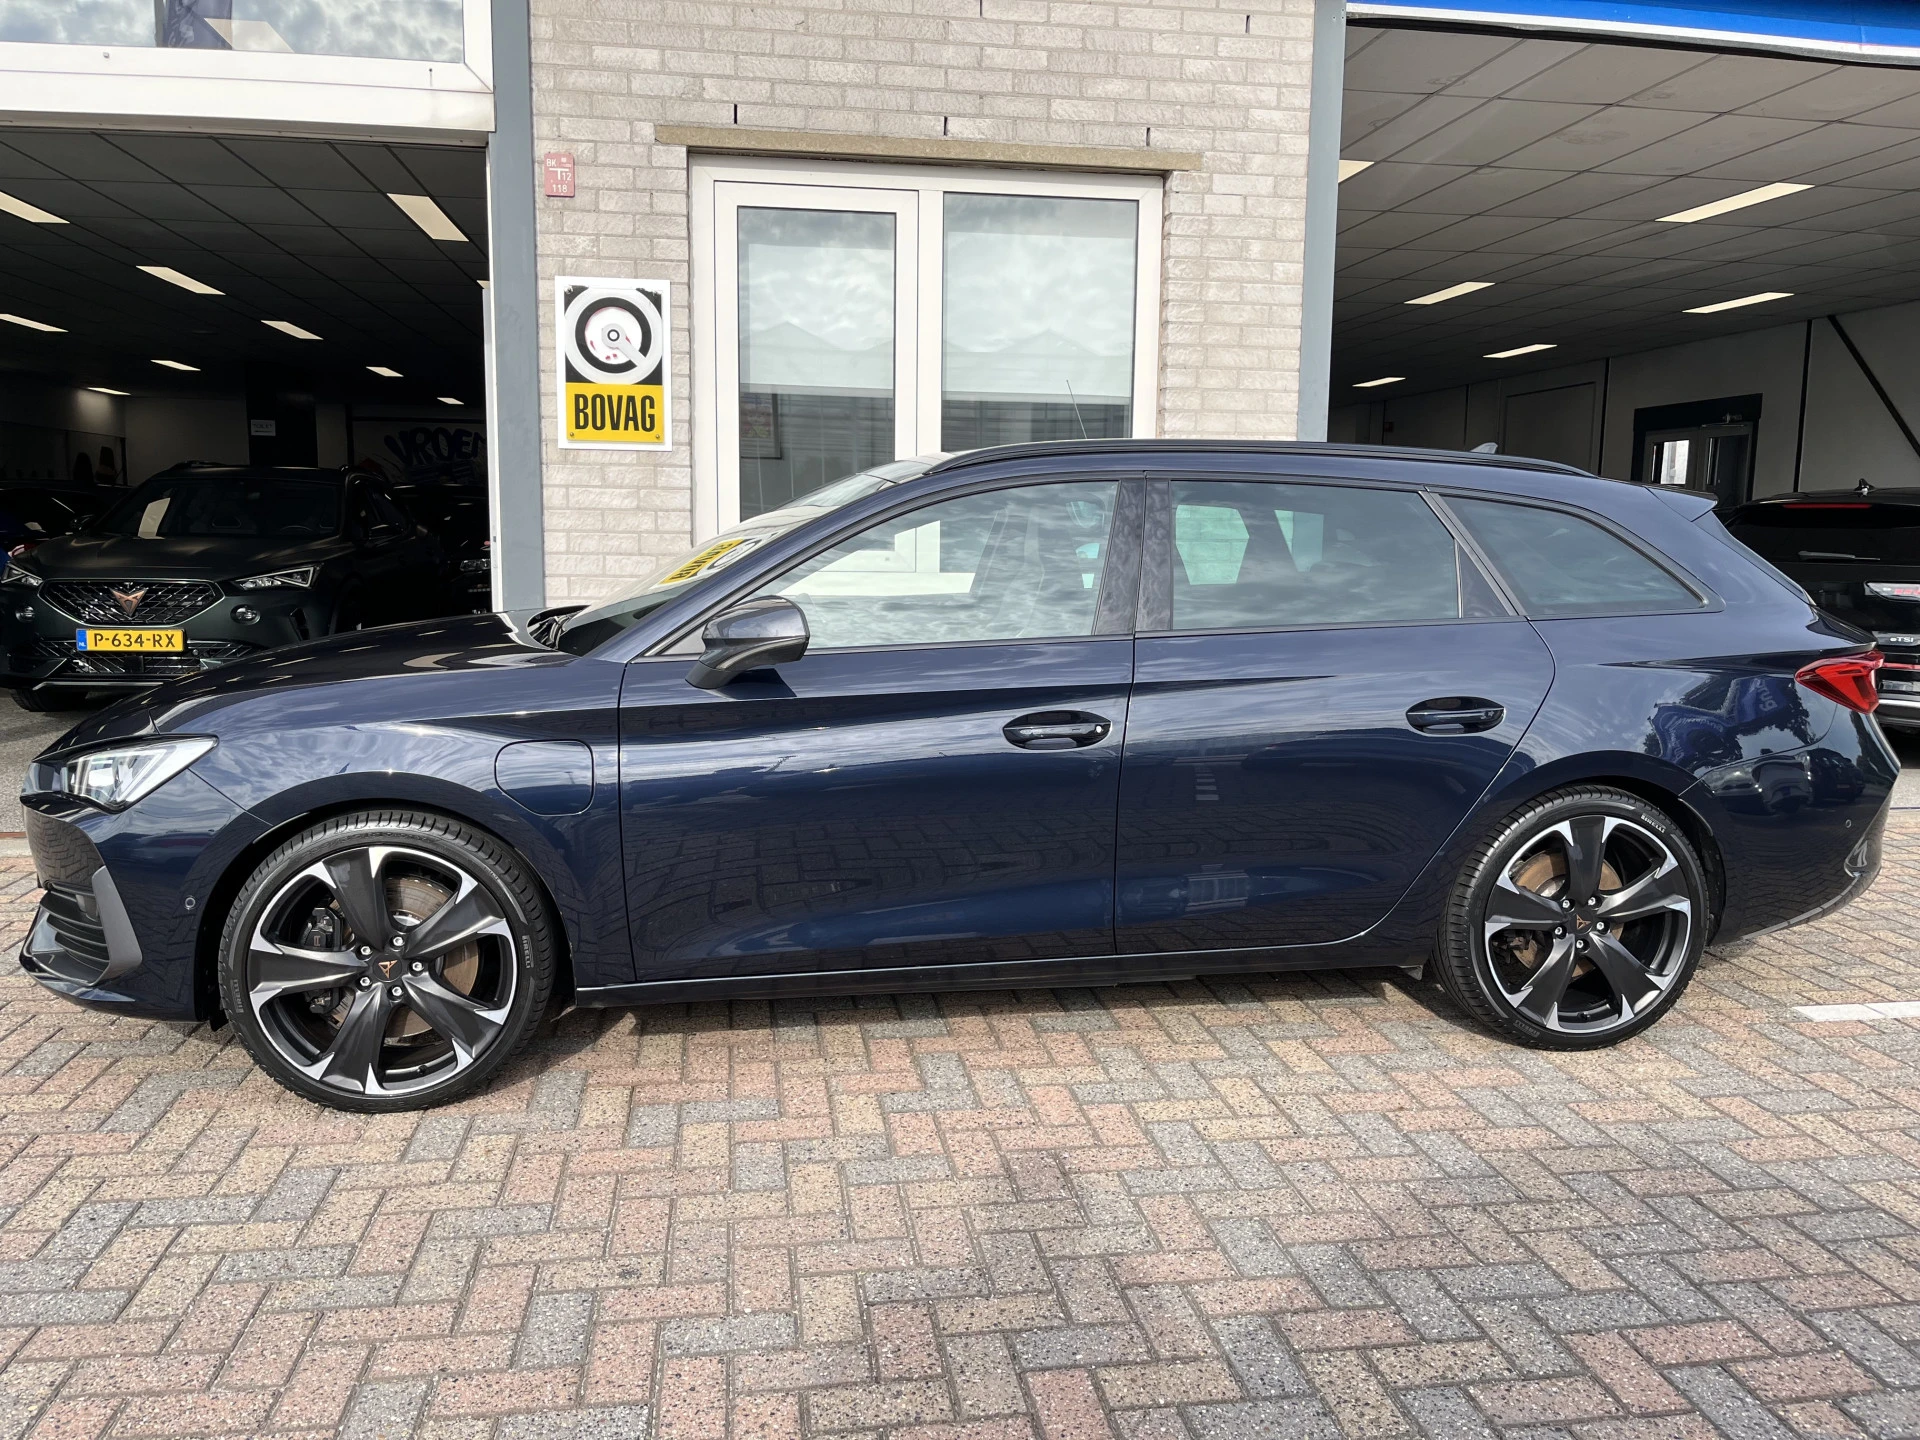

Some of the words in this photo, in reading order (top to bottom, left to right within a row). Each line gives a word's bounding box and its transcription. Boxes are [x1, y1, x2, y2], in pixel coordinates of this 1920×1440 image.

[546, 158, 557, 167] BK
[552, 184, 568, 193] 118
[574, 393, 656, 433] BOVAG
[93, 633, 176, 648] P-634-RX
[522, 935, 535, 969] PIRELLI
